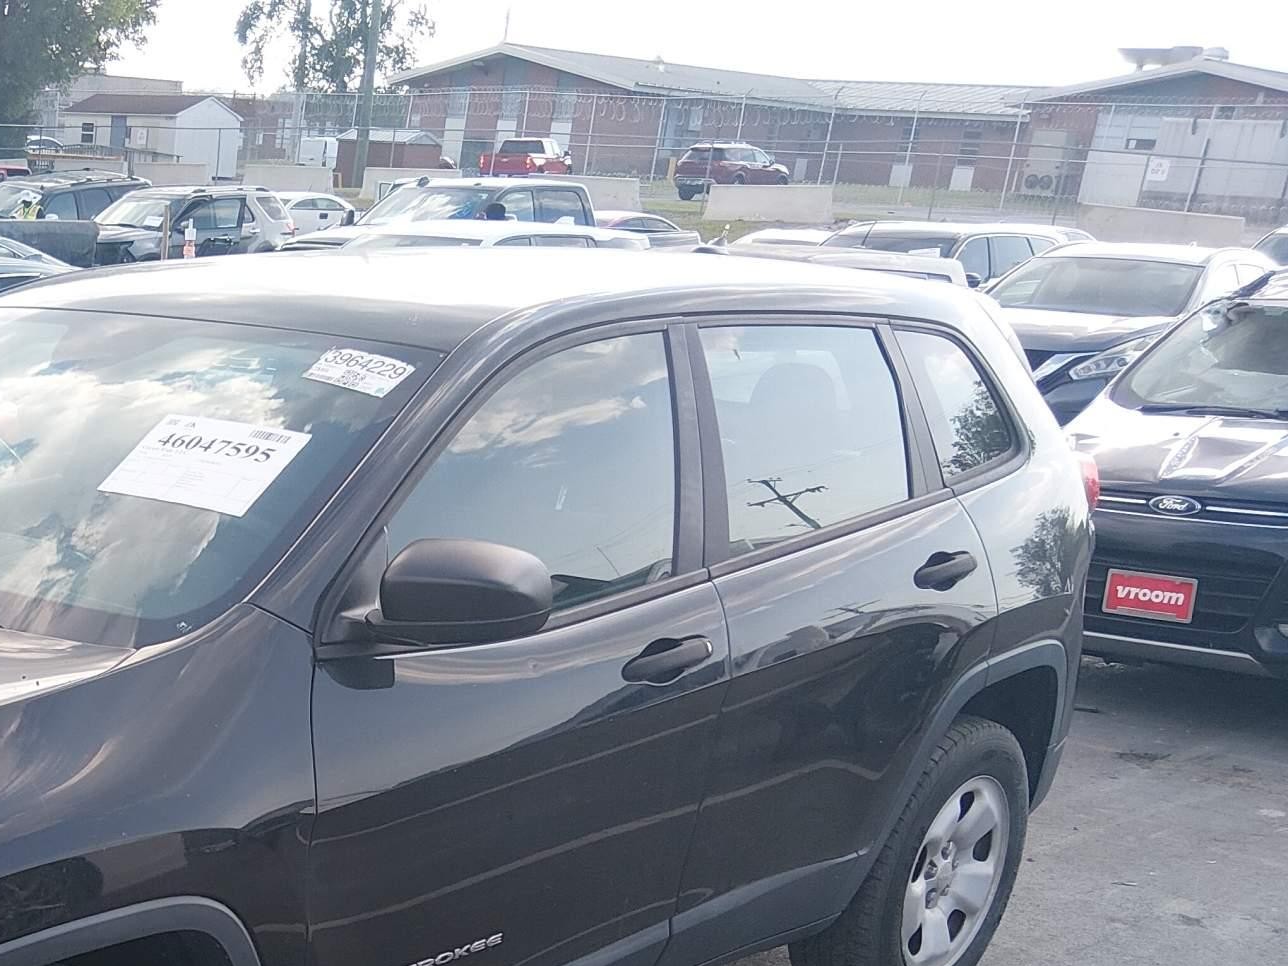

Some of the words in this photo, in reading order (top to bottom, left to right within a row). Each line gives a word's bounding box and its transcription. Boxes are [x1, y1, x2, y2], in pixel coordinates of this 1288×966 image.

[324, 350, 407, 380] 3964229
[158, 432, 278, 463] 46047595
[1158, 497, 1190, 511] Ford
[1116, 585, 1185, 606] vroom
